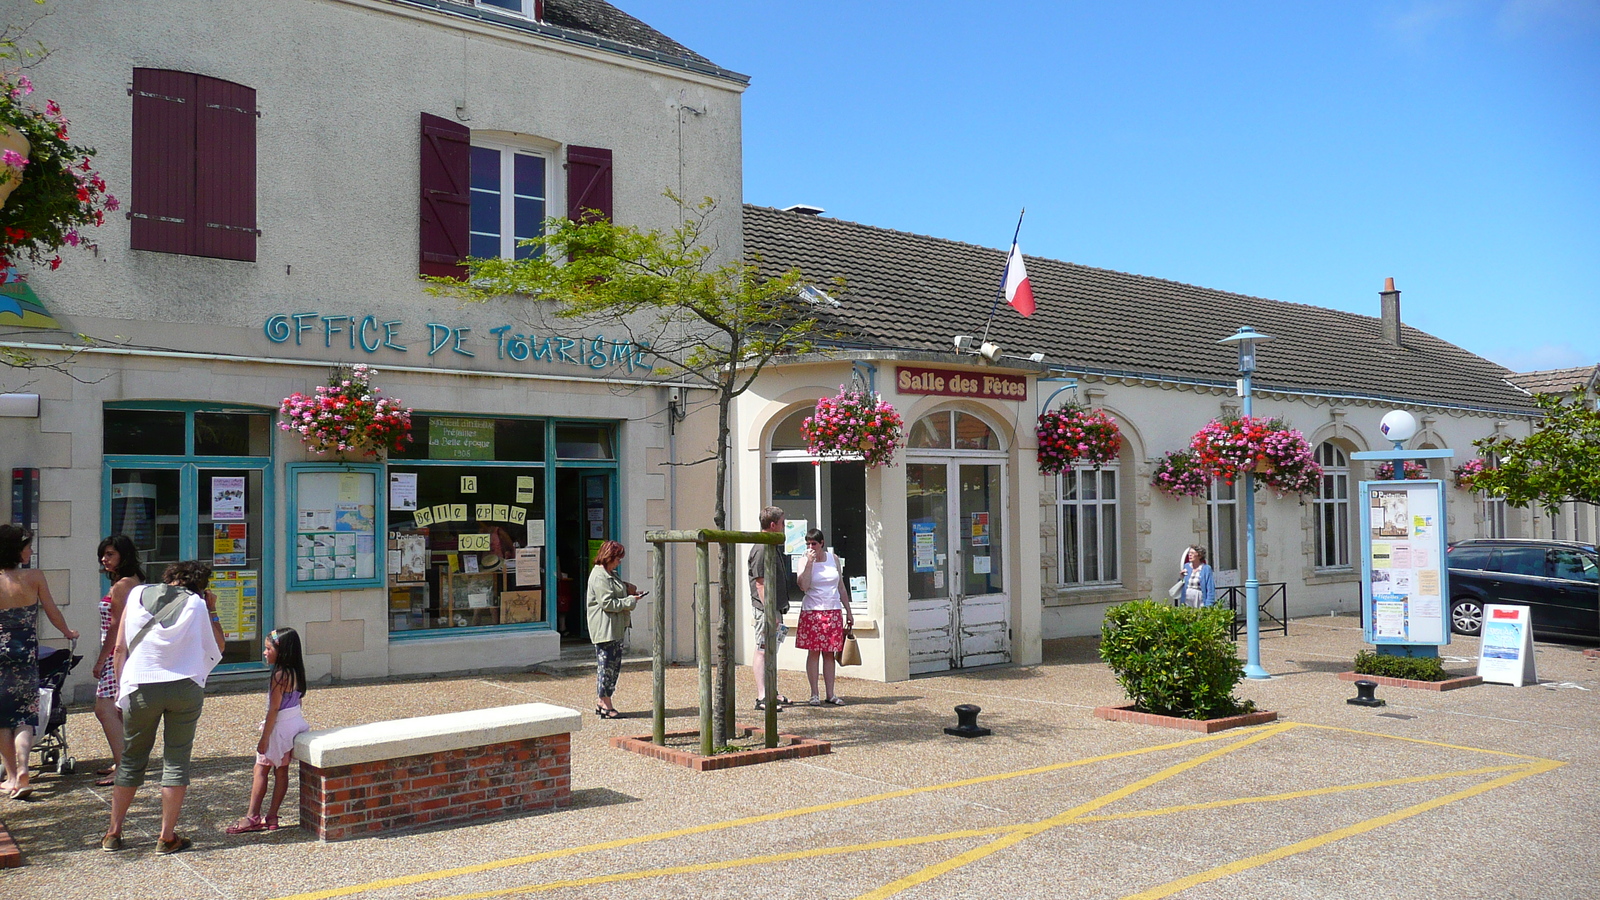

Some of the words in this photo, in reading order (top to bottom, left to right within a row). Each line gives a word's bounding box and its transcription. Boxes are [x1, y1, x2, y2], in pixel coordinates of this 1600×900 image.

[426, 322, 475, 357] DE
[490, 325, 653, 373] TOURISME
[899, 370, 944, 391] Salle
[949, 374, 978, 393] des
[983, 376, 1025, 396] Fêtes
[428, 436, 439, 446] La
[441, 436, 461, 447] Belle
[415, 505, 461, 525] Belle
[476, 505, 524, 523] époque
